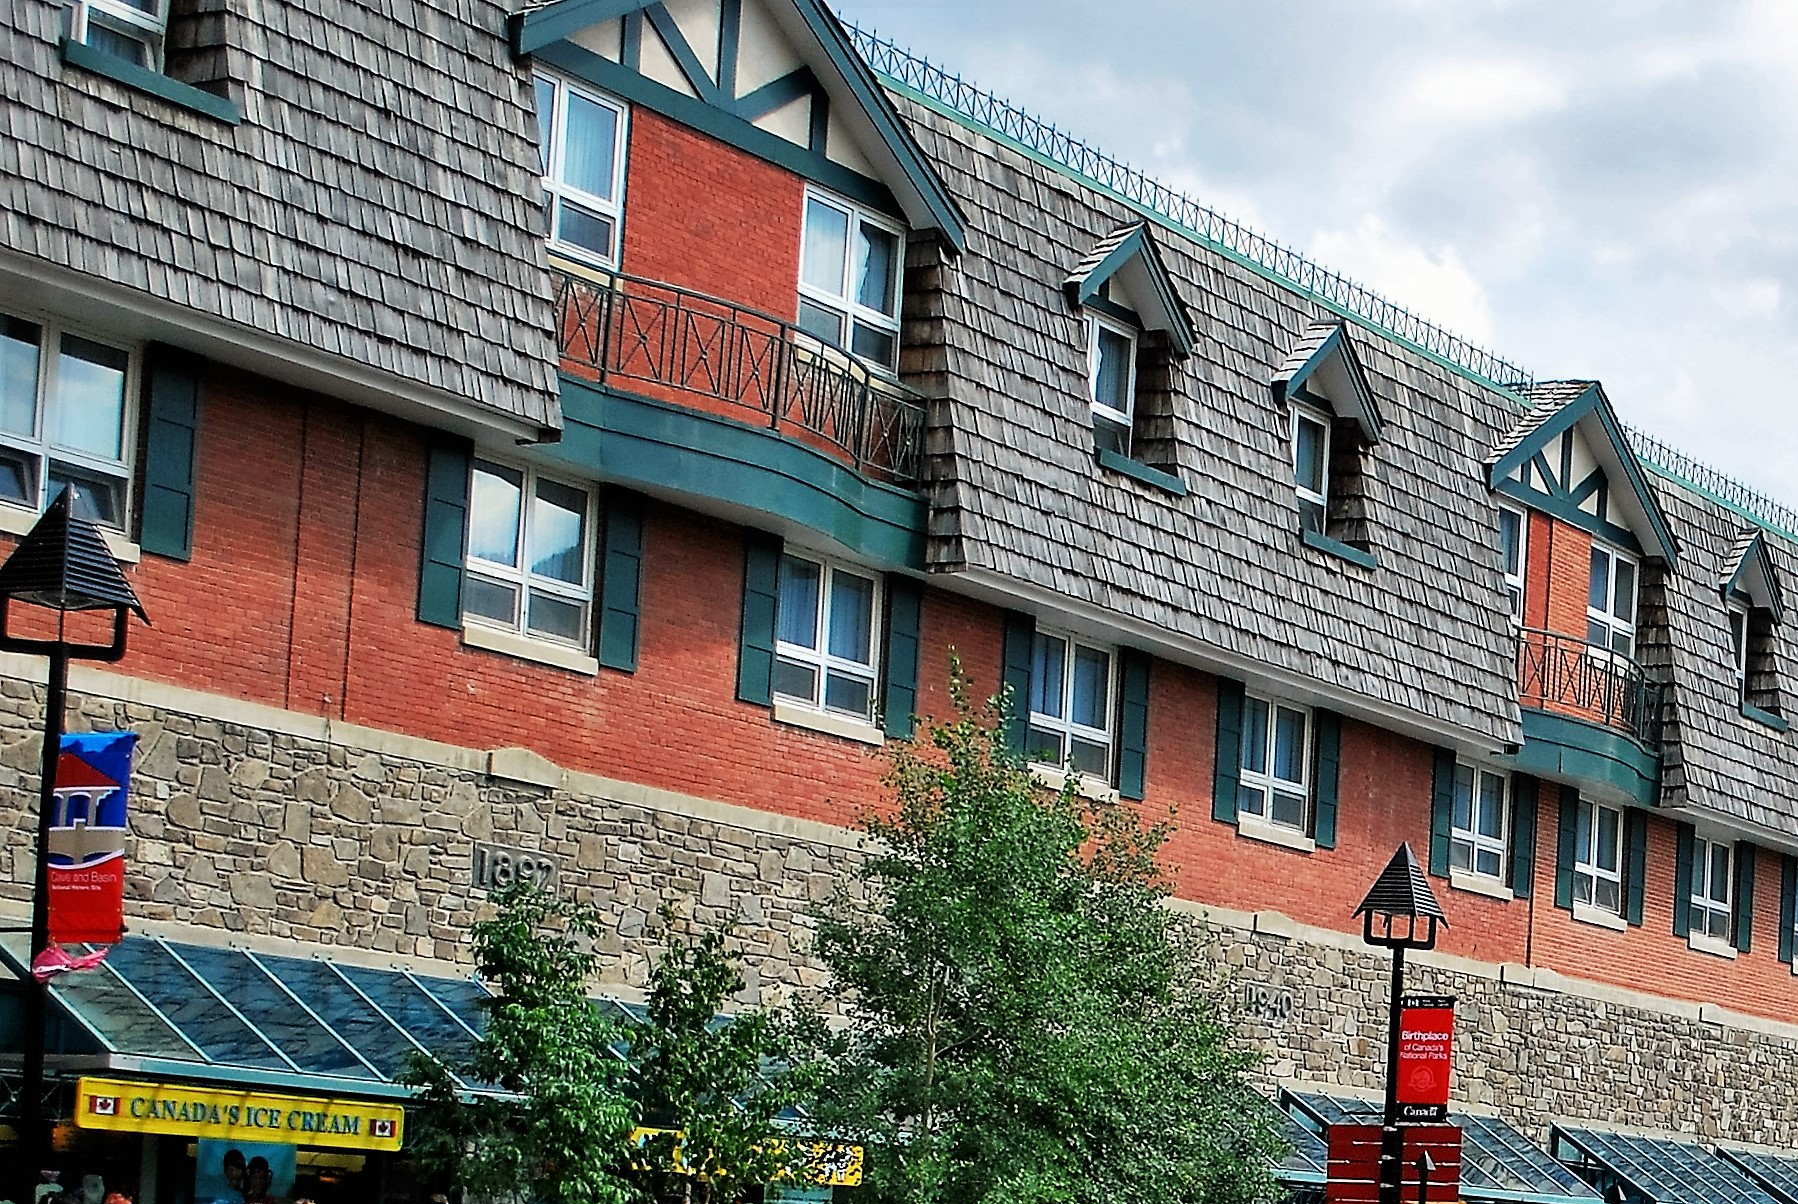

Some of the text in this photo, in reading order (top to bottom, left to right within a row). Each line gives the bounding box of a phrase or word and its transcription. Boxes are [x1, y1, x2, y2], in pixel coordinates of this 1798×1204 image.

[51, 871, 117, 882] Cave and Basin
[1401, 1030, 1449, 1042] Birthplace
[1412, 1043, 1444, 1052] Canada's
[1400, 1051, 1448, 1060] National Parks
[130, 1096, 360, 1135] CANADA'S ICE CREAM
